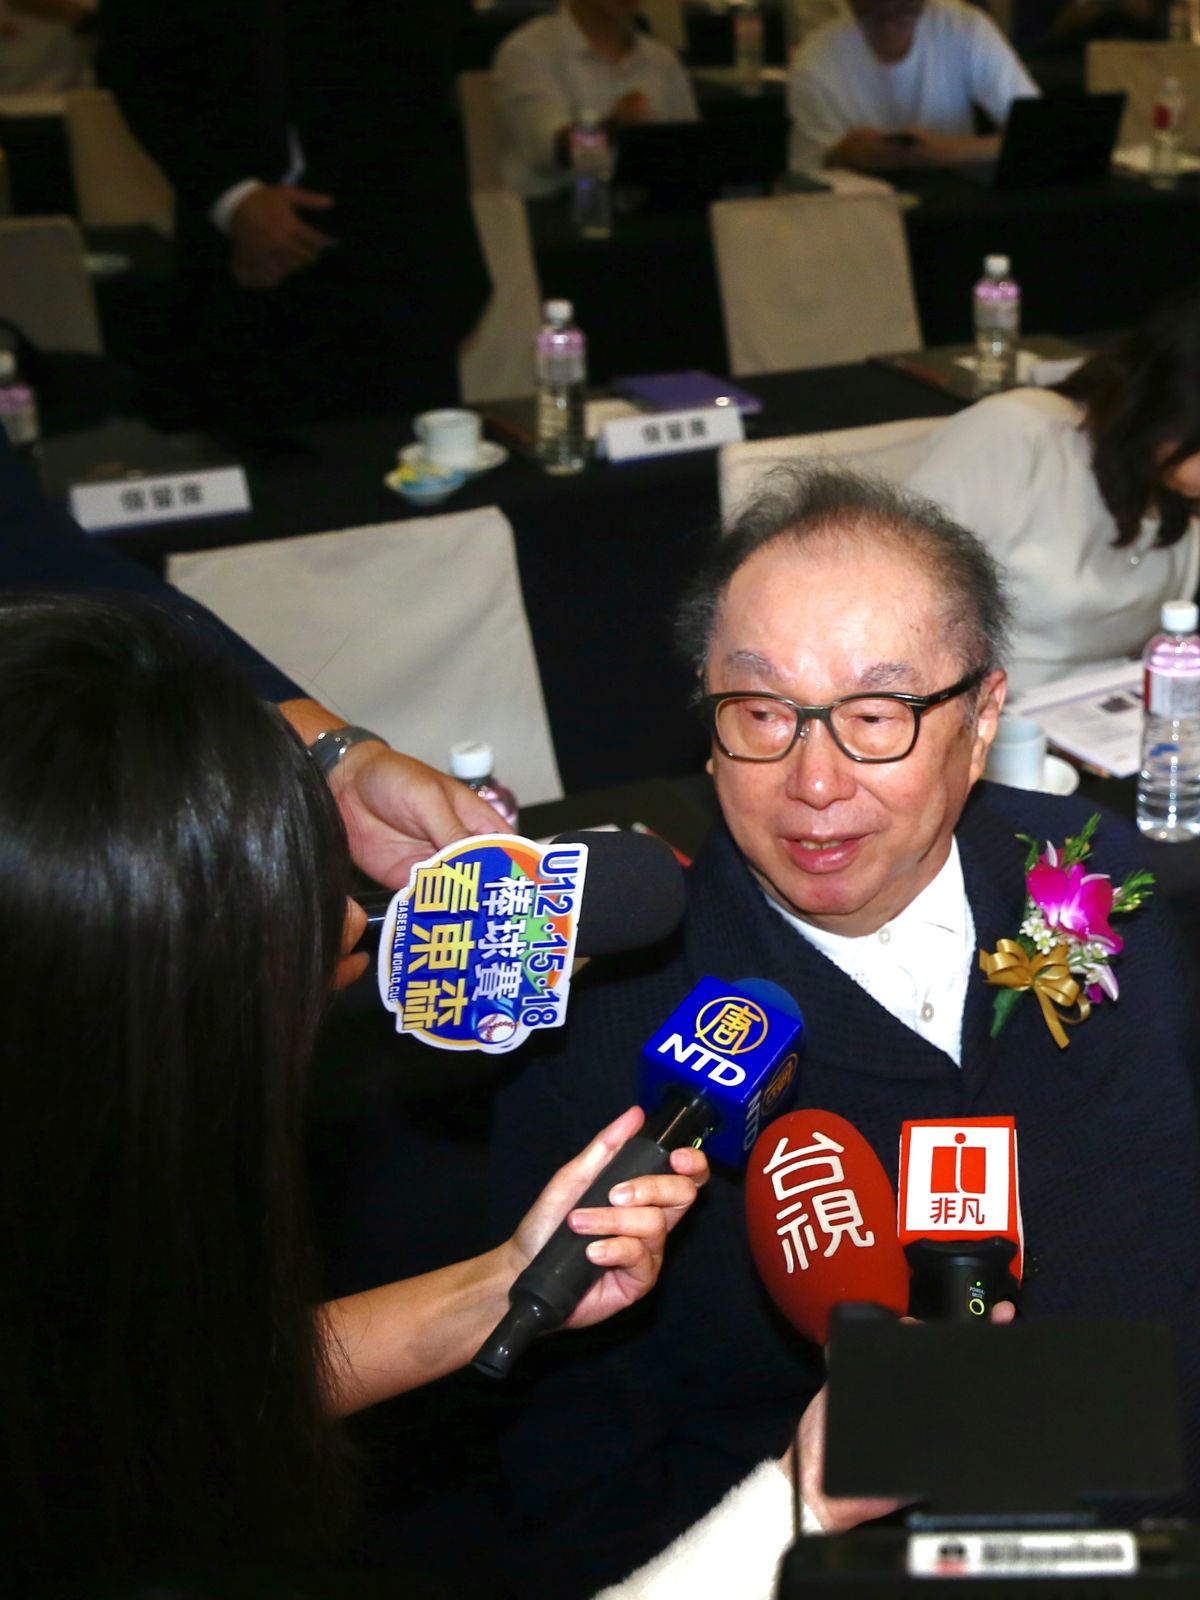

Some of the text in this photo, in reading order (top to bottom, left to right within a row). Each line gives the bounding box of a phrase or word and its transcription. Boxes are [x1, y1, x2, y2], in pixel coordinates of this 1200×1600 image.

[394, 900, 409, 948] BASEBALL
[403, 861, 481, 1031] 看東森
[472, 876, 535, 1001] 棒球賽
[391, 951, 403, 983] WORLD
[657, 1033, 746, 1086] NTD
[744, 1089, 762, 1151] NTD
[762, 1132, 875, 1274] 台視
[930, 1197, 986, 1225] 非凡
